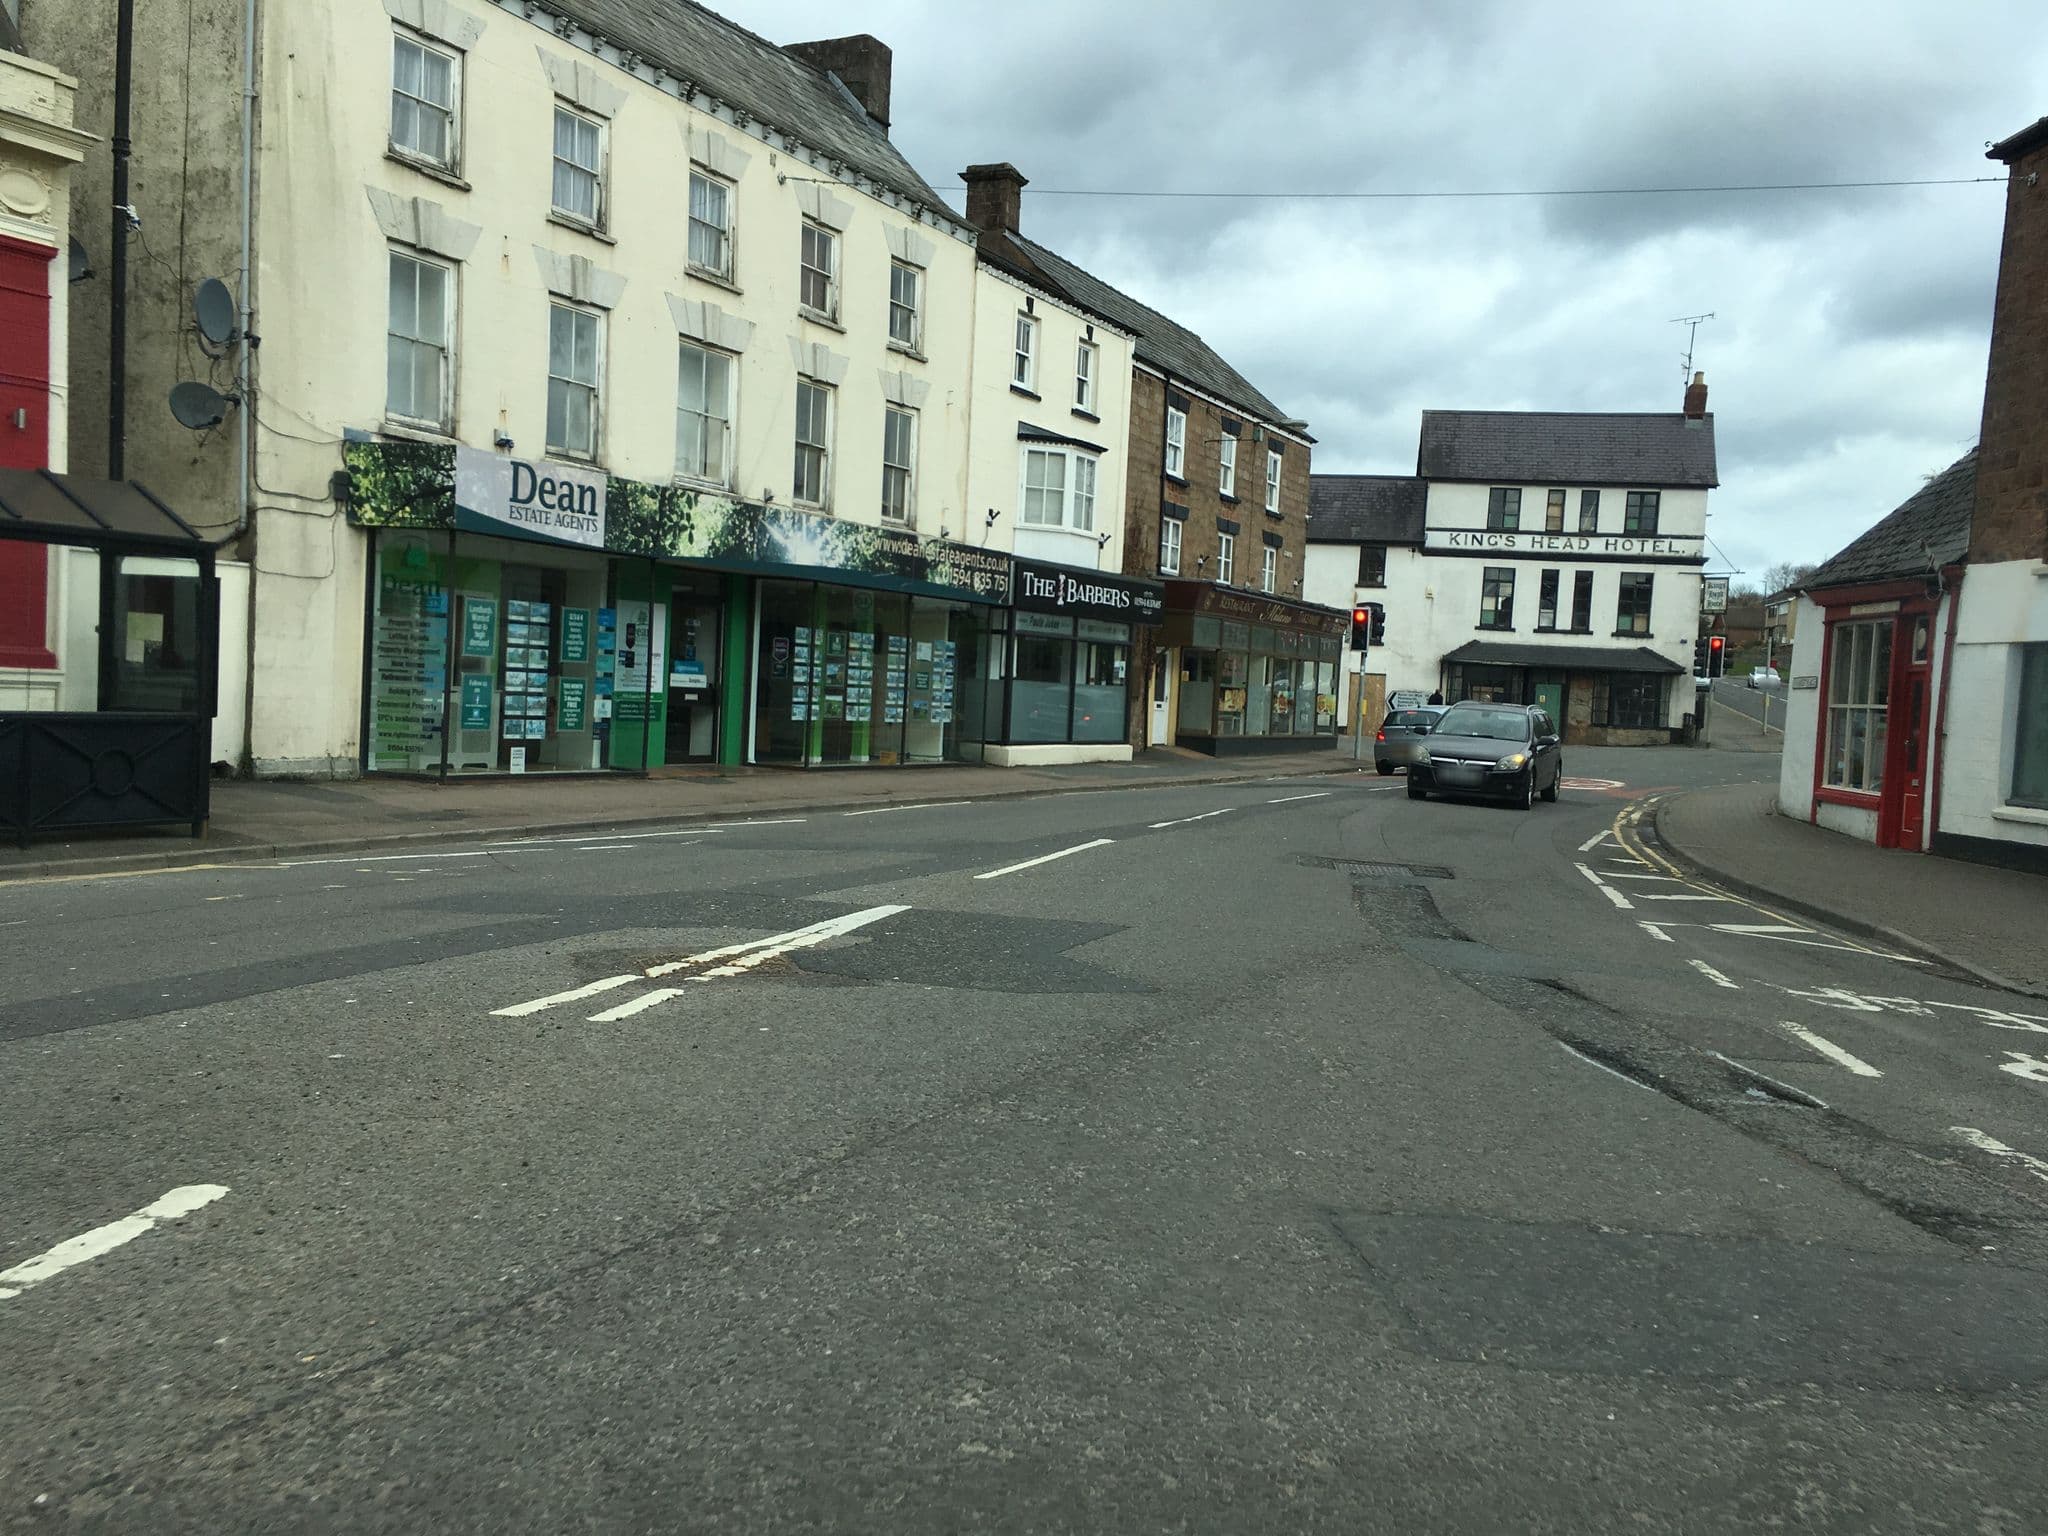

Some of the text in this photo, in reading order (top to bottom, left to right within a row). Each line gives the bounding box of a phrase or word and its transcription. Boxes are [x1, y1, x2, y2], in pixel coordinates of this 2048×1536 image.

[509, 460, 598, 516] Dean
[509, 505, 598, 533] ESTATE AGENTS
[875, 537, 1009, 573] www.deanestateagents.co.uk
[1449, 533, 1516, 548] KING'S
[1531, 536, 1590, 551] HEAD
[942, 565, 971, 585] 01594
[994, 573, 1009, 592] 751
[1023, 571, 1056, 598] THE
[1066, 579, 1130, 608] BARBERS
